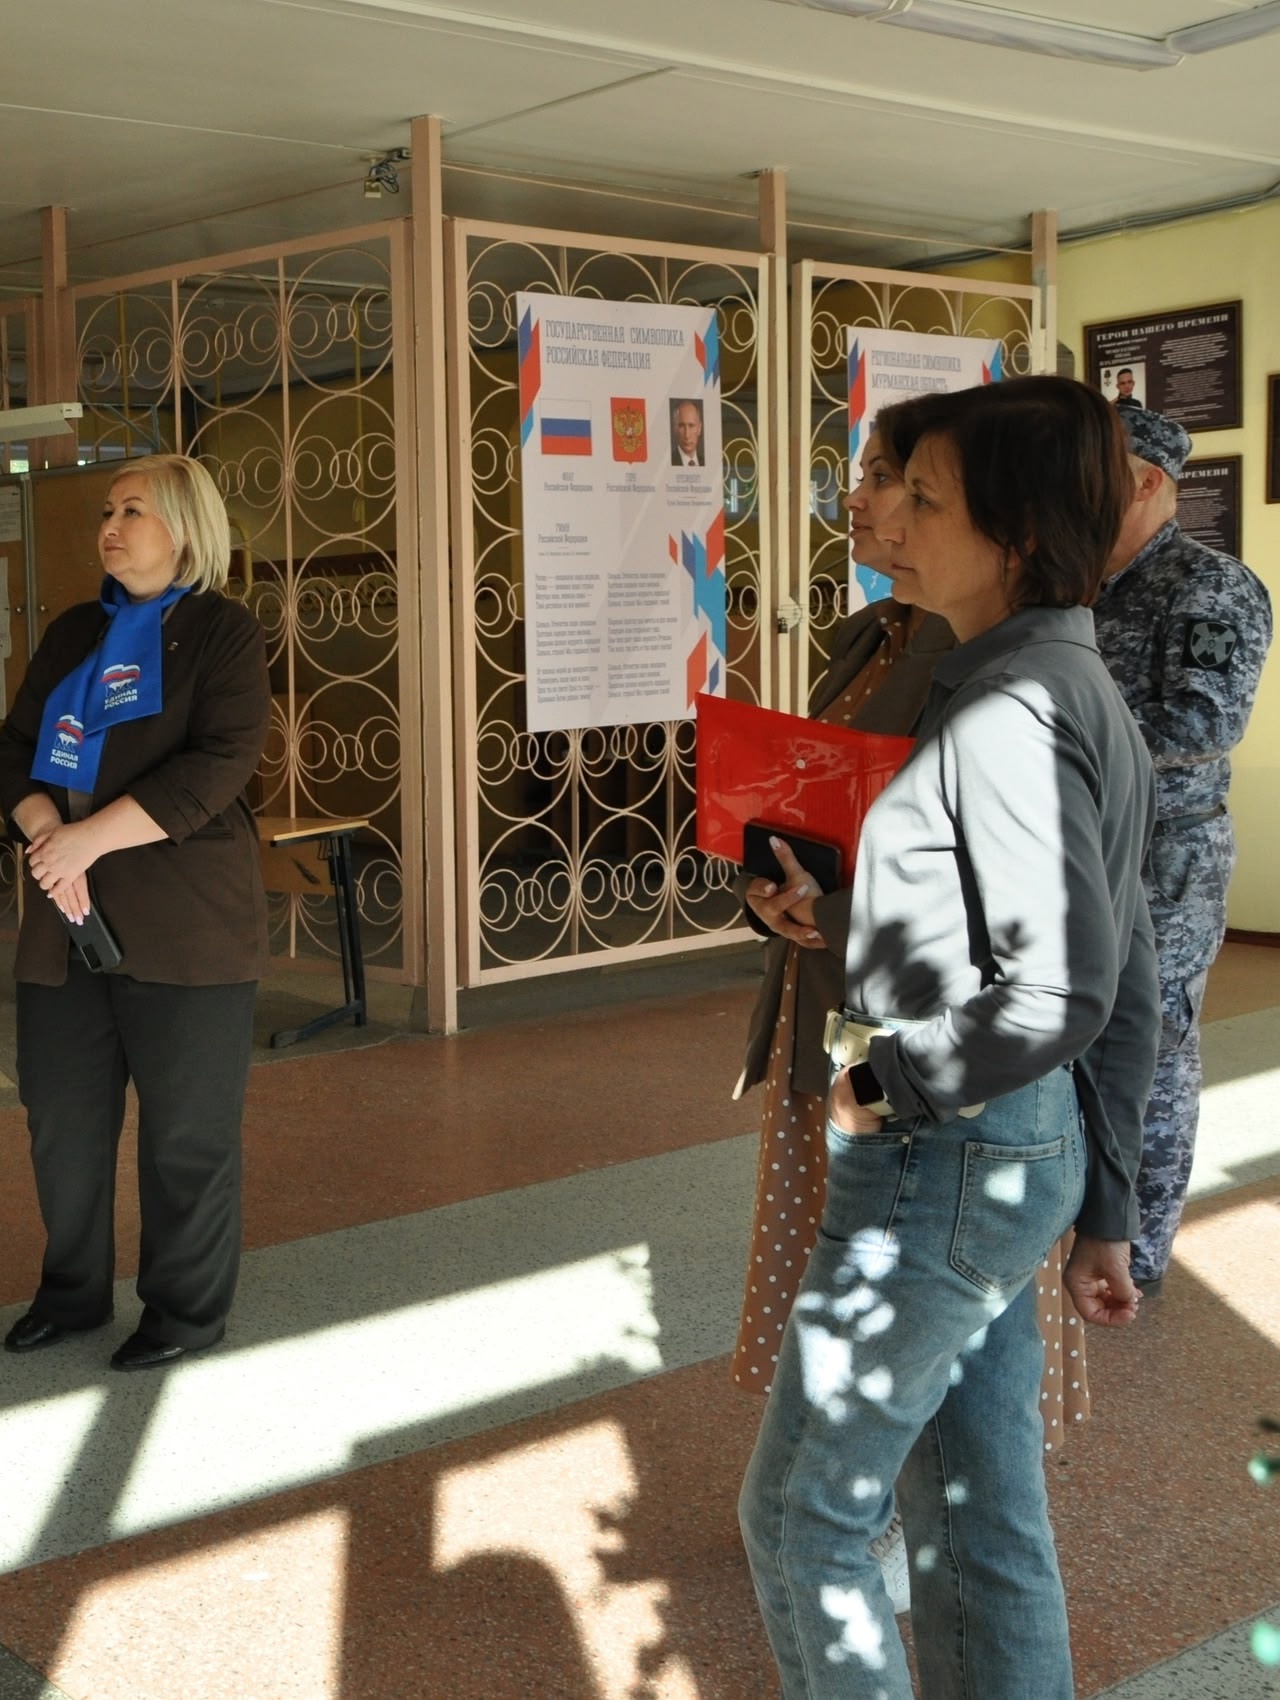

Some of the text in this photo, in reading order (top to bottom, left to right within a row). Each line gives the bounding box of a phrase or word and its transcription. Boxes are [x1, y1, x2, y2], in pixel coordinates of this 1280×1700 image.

[1131, 323, 1175, 336] НАШЕГО
[1177, 313, 1229, 328] ВРЕМЕНИ
[545, 320, 684, 346] ГОСУДАРСТВЕННАЯ СИМВОЛИКА
[546, 345, 651, 370] РОССИЙСКАЯ ФЕДЕРАЦИЯ
[104, 688, 138, 704] ЕДИНАЯ
[104, 694, 138, 710] РОССИЯ
[50, 755, 78, 770] РОССИЯ
[51, 748, 79, 762] ЕДИНАЯ
